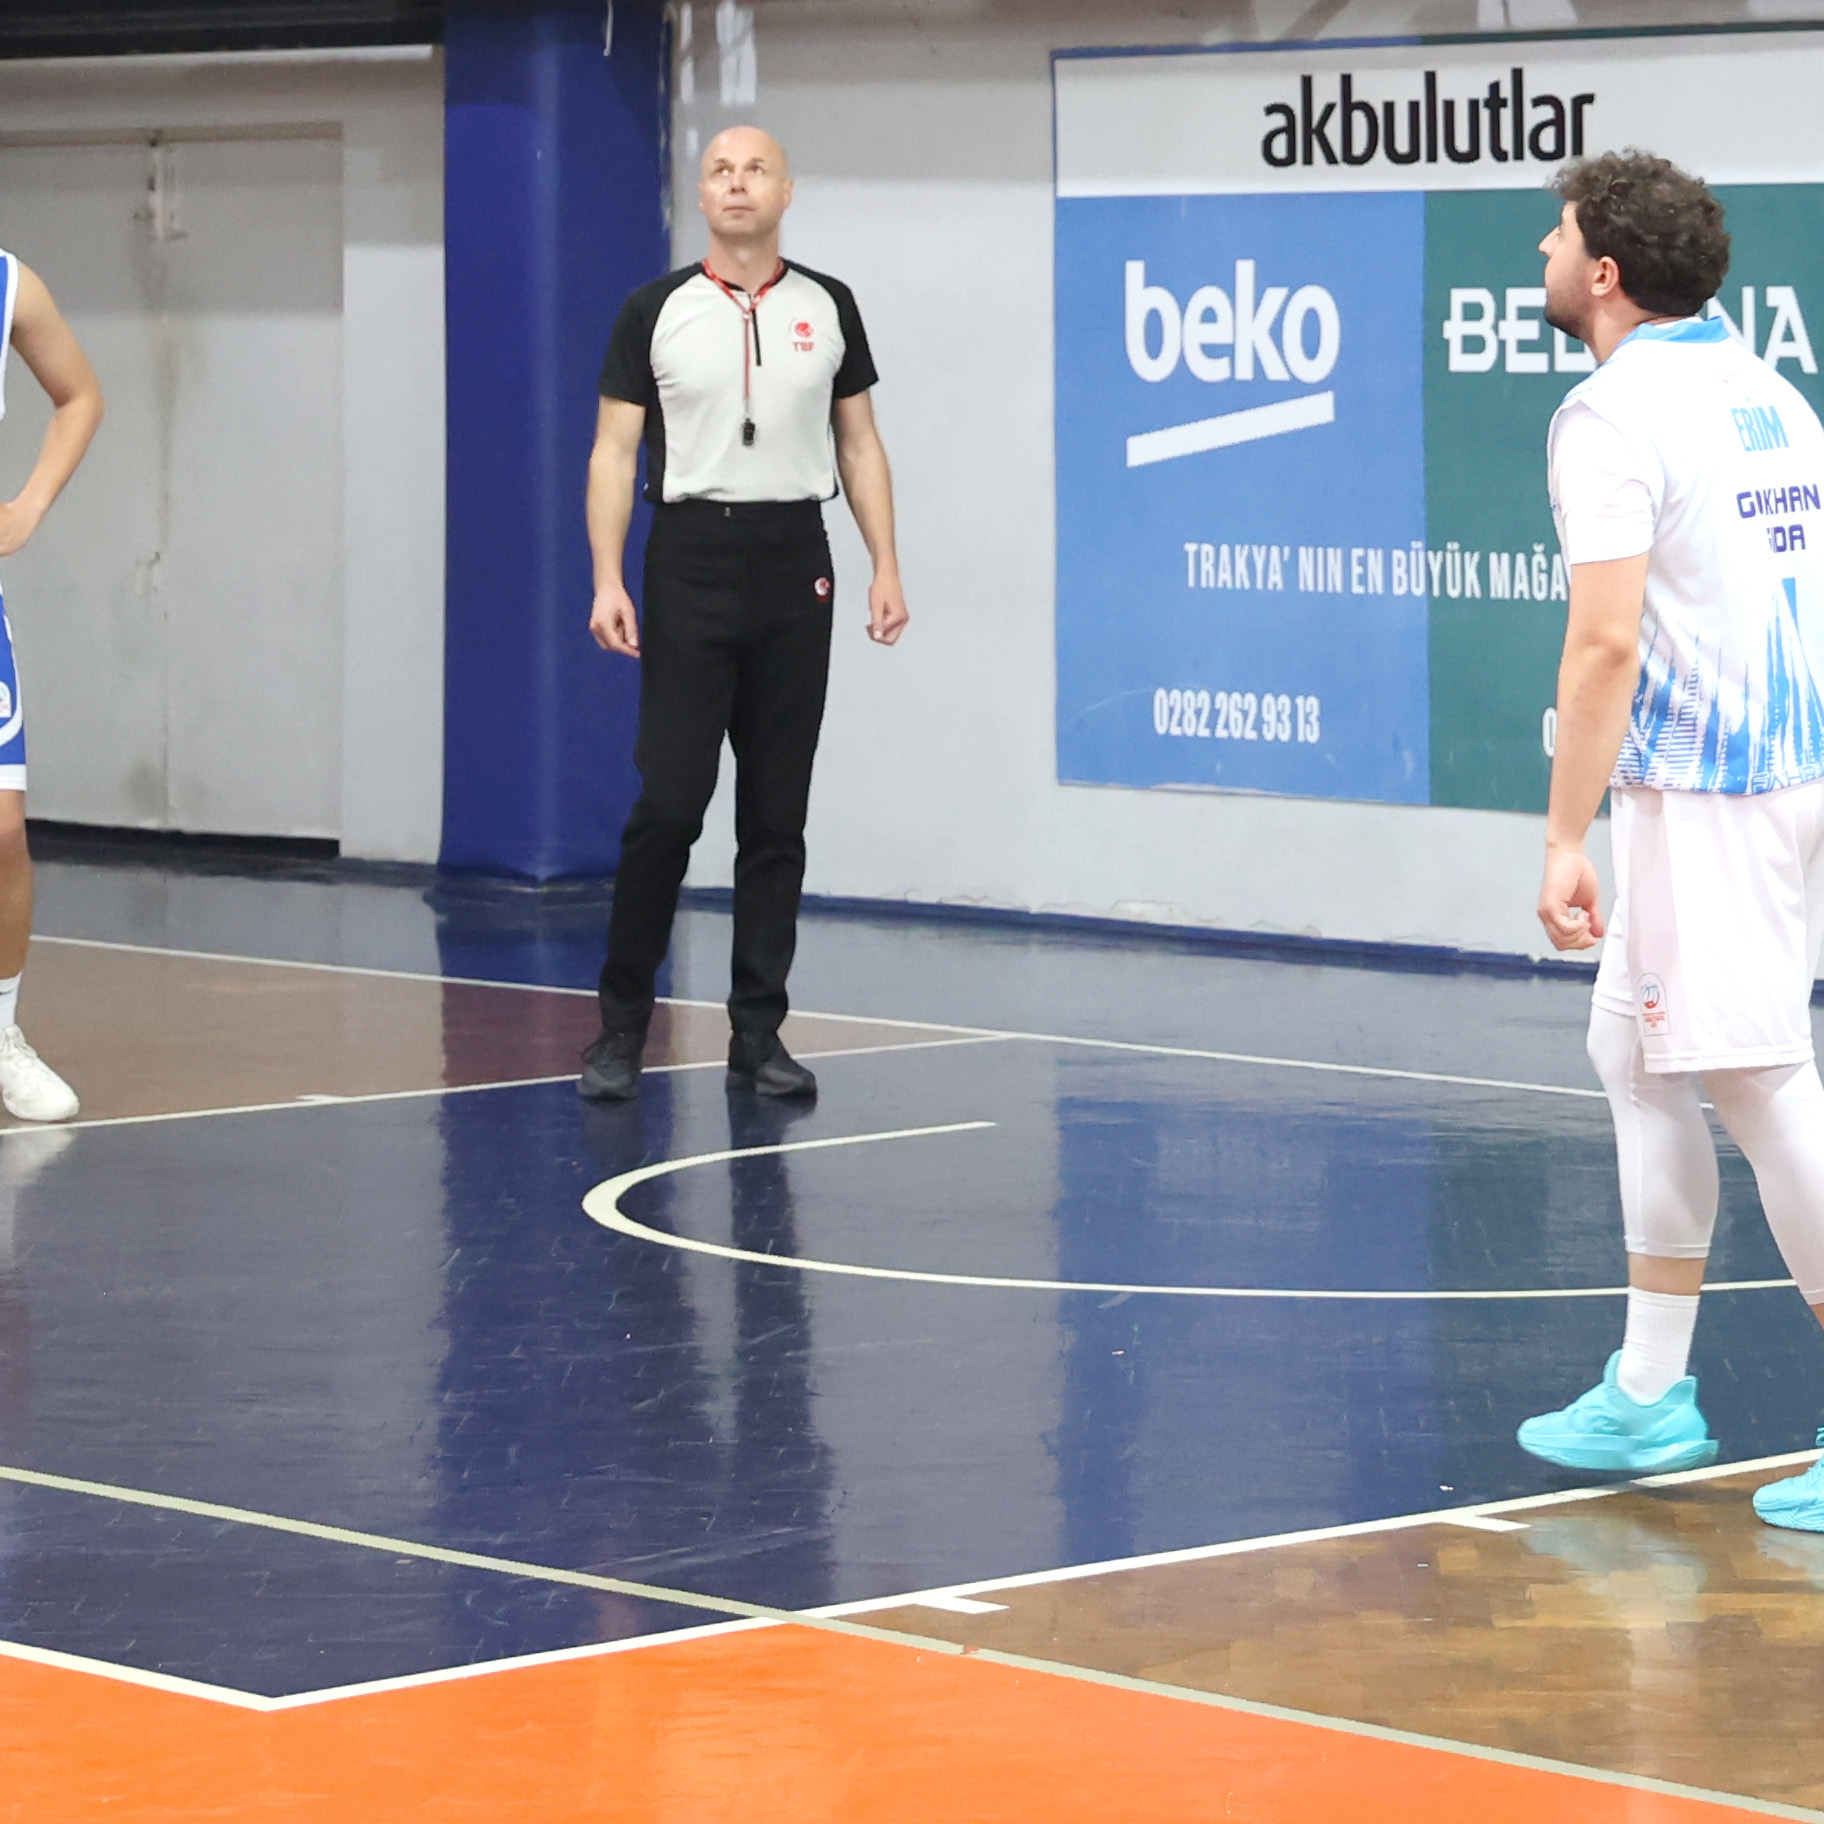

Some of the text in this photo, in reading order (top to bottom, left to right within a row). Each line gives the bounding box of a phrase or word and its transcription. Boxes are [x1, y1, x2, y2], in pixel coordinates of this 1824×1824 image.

[1261, 67, 1596, 169] akbulutlar
[1124, 259, 1341, 384] beko
[1298, 545, 1344, 594] NIN
[1350, 546, 1385, 596] EN
[1392, 540, 1482, 600] BÜYÜK
[1489, 542, 1568, 602] MAĞA
[1152, 687, 1321, 744] 0282 262 93 13
